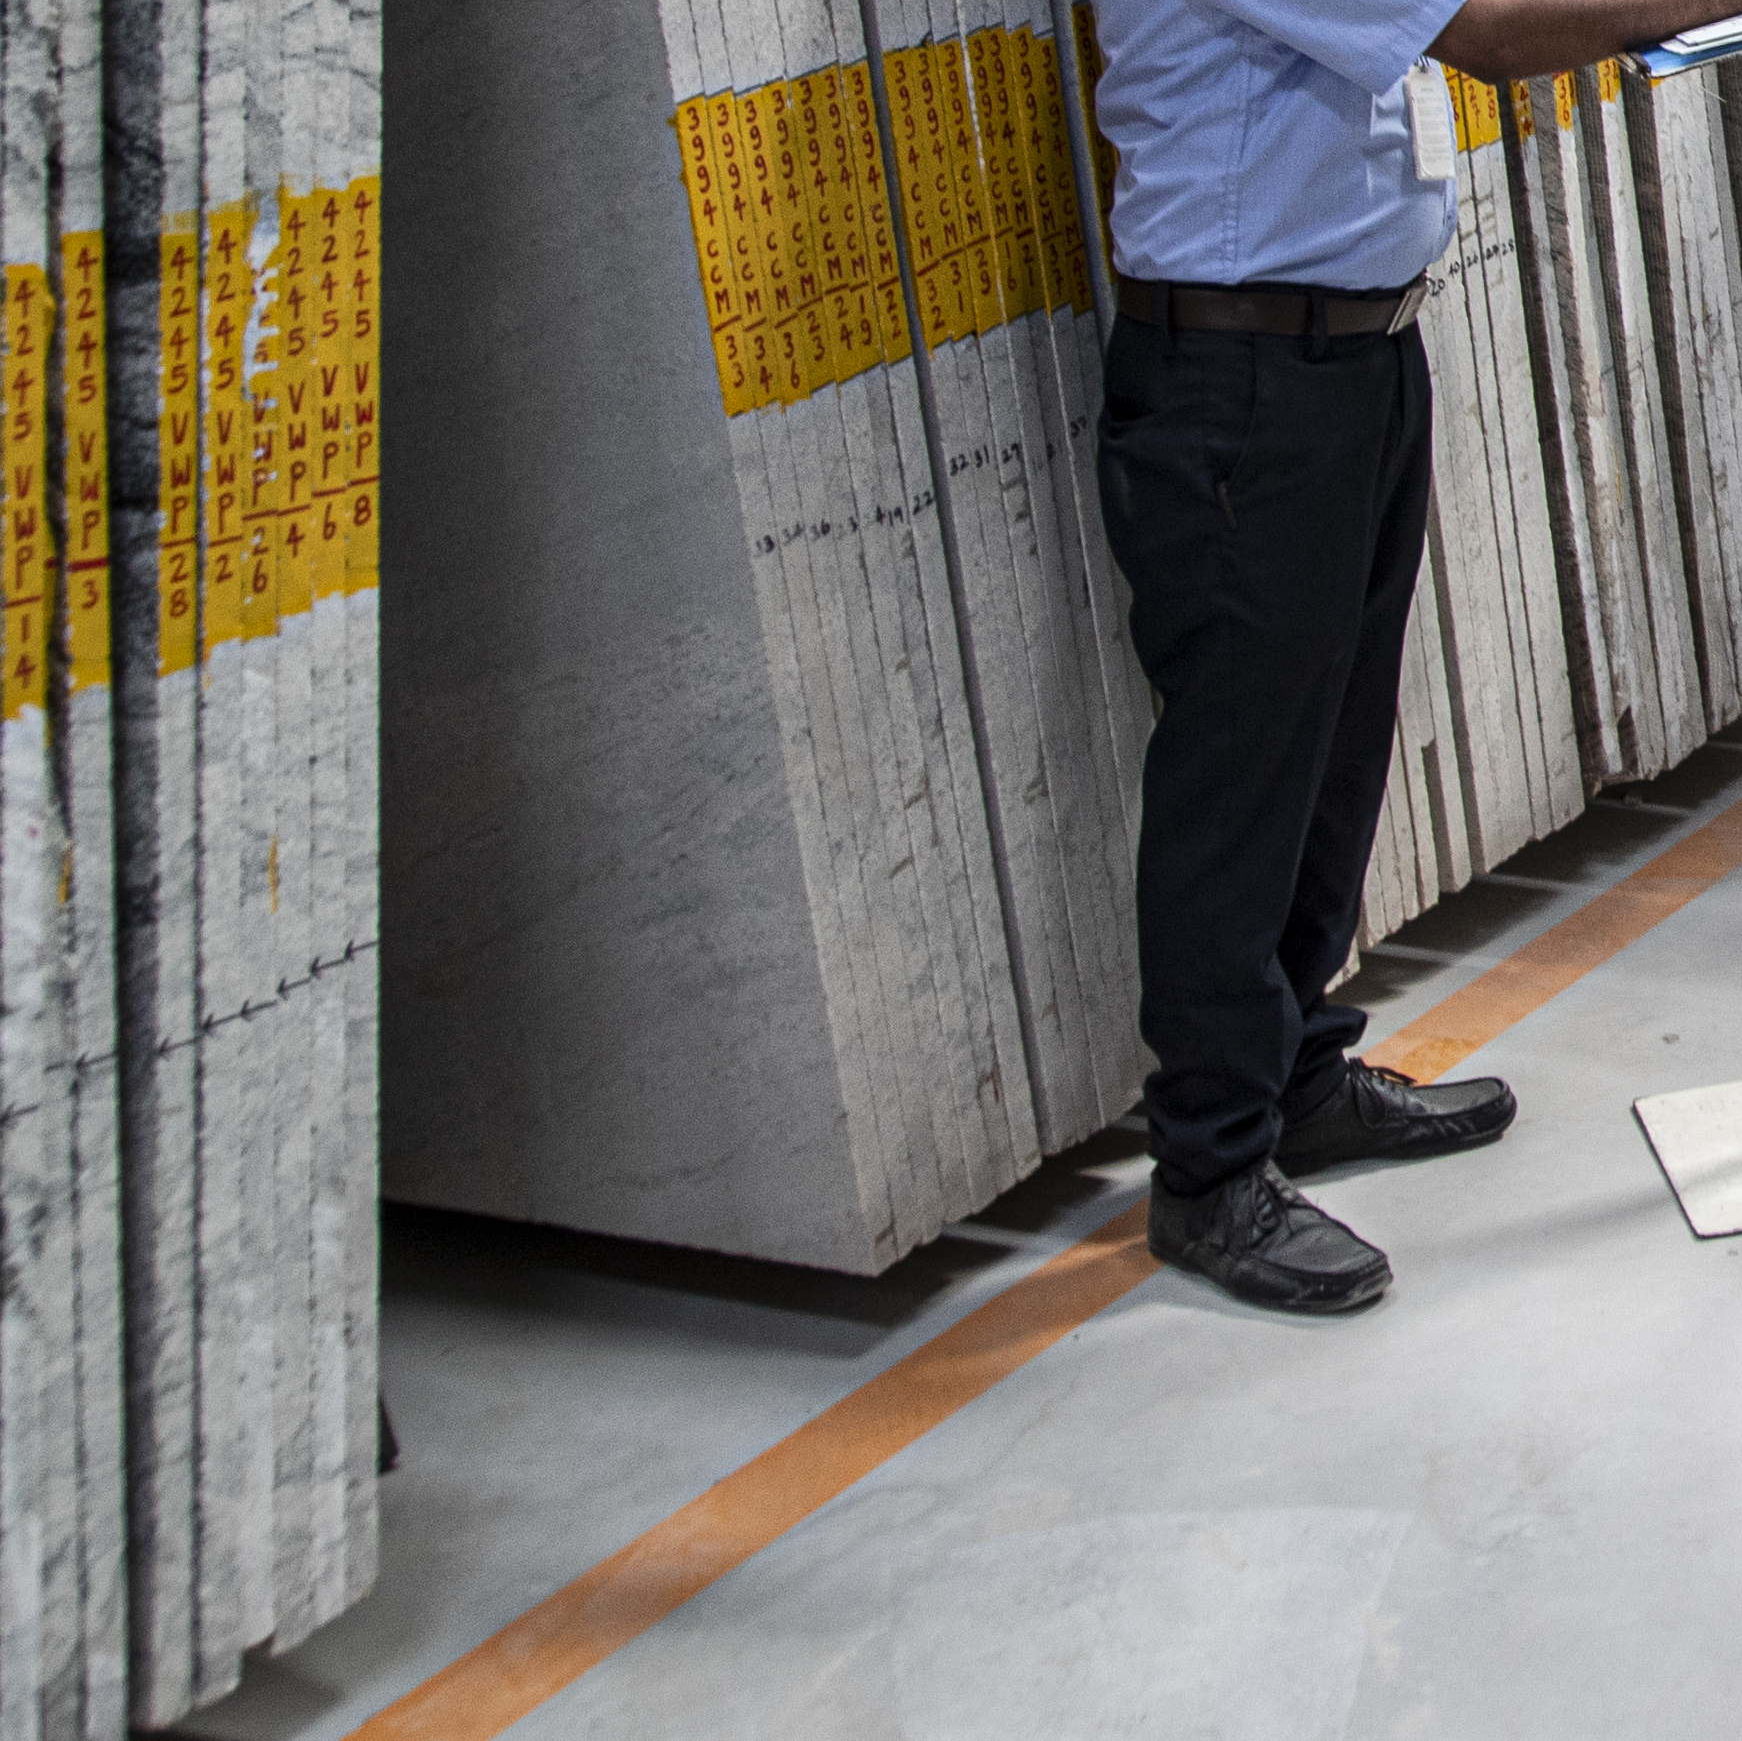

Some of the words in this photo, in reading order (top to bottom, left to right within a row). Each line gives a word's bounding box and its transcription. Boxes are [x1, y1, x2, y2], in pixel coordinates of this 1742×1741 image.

[850, 70, 882, 192] 3994
[870, 203, 894, 272] CCM
[884, 291, 903, 338] 22
[894, 60, 921, 171] 3994
[911, 183, 935, 259] CCM
[927, 283, 946, 329] 32
[918, 53, 946, 163] 3994
[936, 174, 959, 245] CCM
[950, 261, 966, 312] 31
[944, 44, 972, 153] 3994
[961, 167, 984, 233] CCM
[975, 248, 993, 295] 29
[972, 41, 998, 146] 3994
[989, 156, 1010, 226] CCM
[989, 34, 1017, 147] 3994
[1007, 157, 1029, 224] CCM
[1020, 245, 1037, 287] 21
[1016, 32, 1045, 153] 3994
[1035, 165, 1057, 231] CCM
[1042, 45, 1067, 155] 3994
[1059, 173, 1081, 241] CCM
[285, 210, 308, 356] 4245
[320, 197, 342, 339] 4245
[353, 190, 374, 337] 4245
[686, 107, 719, 227] 3994
[706, 237, 732, 313] CCM
[724, 334, 746, 388] 33
[716, 103, 748, 220] 3994
[736, 236, 762, 313] CCM
[754, 336, 773, 392] 34
[745, 99, 775, 216] 3994
[765, 231, 792, 310] CCM
[782, 333, 801, 388] 36
[772, 89, 801, 207] 3994
[792, 224, 816, 297] CCM
[807, 312, 826, 360] 23
[800, 79, 828, 196] 3994
[818, 205, 844, 278] CCM
[836, 296, 855, 350] 24
[824, 73, 853, 192] 3994
[843, 203, 867, 275] CCM
[858, 295, 874, 346] 19
[12, 279, 39, 440] 4245
[75, 246, 99, 405] 4245
[167, 246, 193, 393] 4245
[215, 228, 238, 391] 4245
[170, 412, 193, 536] VWP
[217, 411, 236, 536] VWP
[288, 382, 308, 503] VWP
[321, 364, 342, 479] VWP
[355, 362, 375, 468] VWP
[13, 466, 38, 592] VWP
[79, 431, 102, 551] VWP
[251, 526, 271, 593] 26
[286, 522, 306, 558] 4
[323, 503, 338, 541] 6
[353, 494, 373, 526] 8
[81, 580, 100, 608] 3
[168, 553, 189, 617] 28
[215, 553, 235, 582] 2
[13, 611, 38, 689] 14
